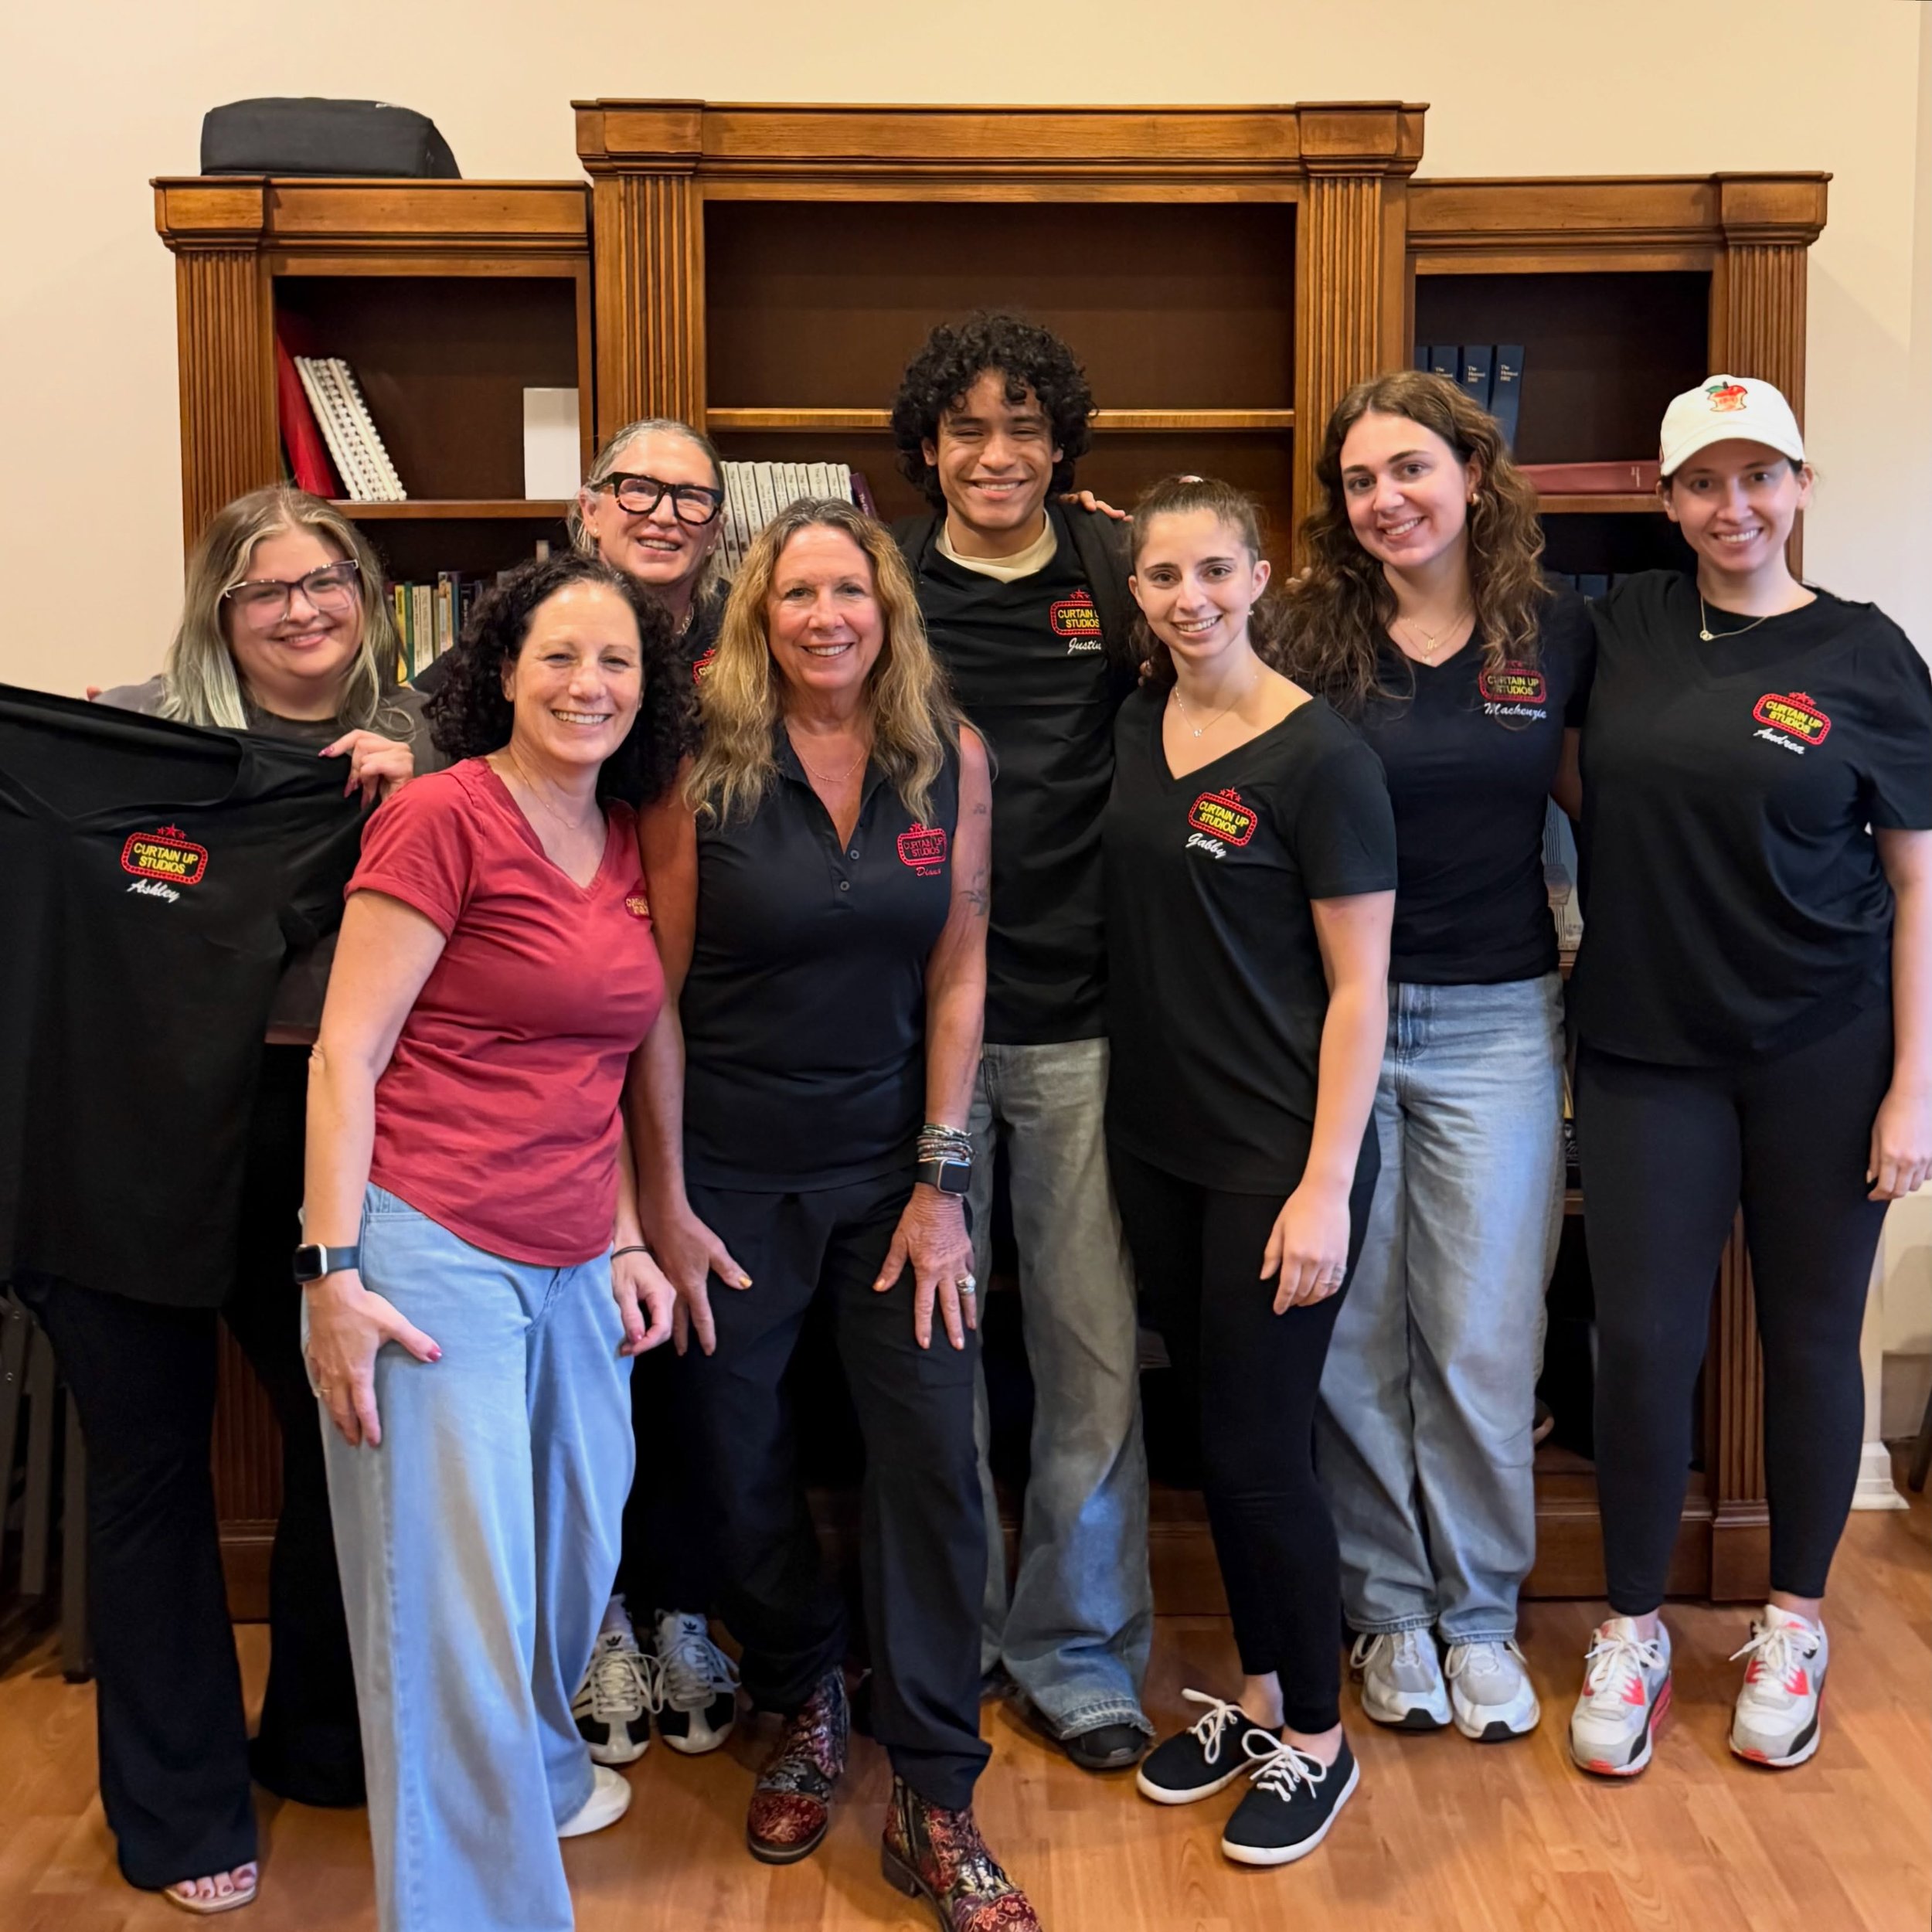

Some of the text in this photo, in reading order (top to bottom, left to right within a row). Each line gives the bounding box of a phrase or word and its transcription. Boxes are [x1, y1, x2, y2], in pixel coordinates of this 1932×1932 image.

[1057, 609, 1094, 619] CURTAIN
[1066, 619, 1100, 628] STUDIOS
[1067, 637, 1102, 655] Justin
[1527, 677, 1539, 687] UP
[1484, 702, 1547, 721] Mackenzie
[1765, 700, 1824, 729] CURTAIN UP
[1768, 710, 1811, 734] STUDIOS
[1199, 801, 1250, 828] CURTAIN UP
[1199, 812, 1237, 835] STUDIOS
[134, 842, 199, 865] CURTAIN UP
[912, 846, 940, 857] STUDIOS
[1185, 832, 1226, 859] Gabby
[138, 855, 185, 875] STUDIOS
[126, 878, 180, 903] Ashley
